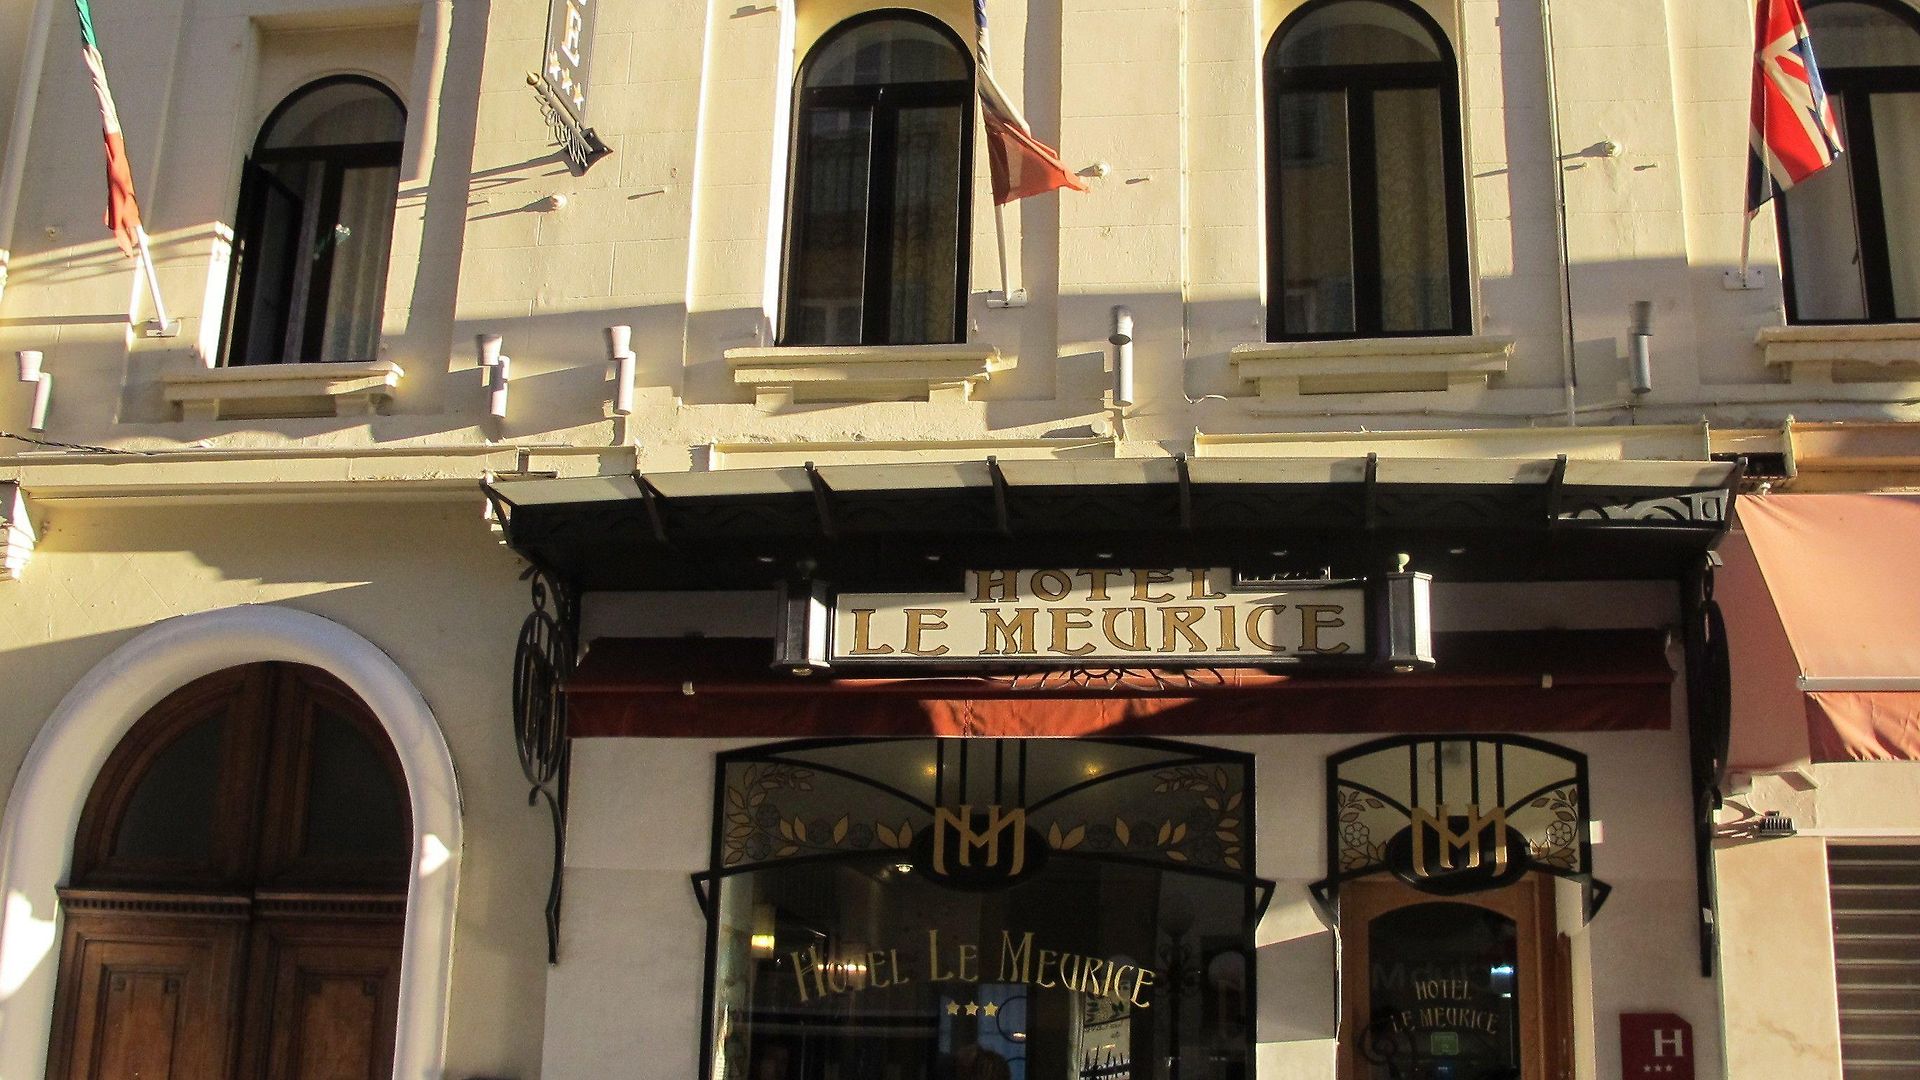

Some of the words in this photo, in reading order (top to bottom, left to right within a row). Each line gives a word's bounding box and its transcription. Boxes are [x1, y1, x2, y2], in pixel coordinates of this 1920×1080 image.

[970, 568, 1227, 603] HOTEL
[849, 608, 950, 656] LE
[979, 604, 1350, 656] MEURICE
[789, 946, 910, 1002] HOEL
[1415, 979, 1472, 1001] HOTEL
[1390, 1010, 1416, 1033] LE
[1420, 1007, 1499, 1035] MEURICE
[1653, 1029, 1684, 1057] H
